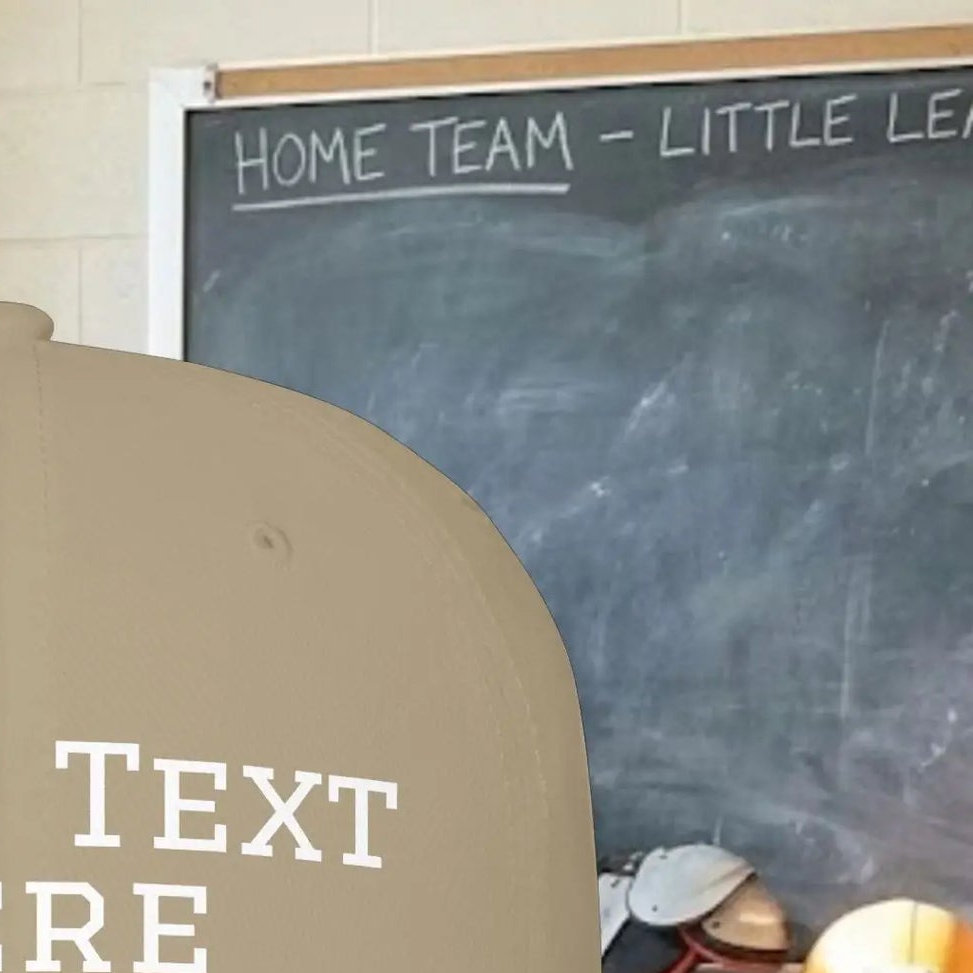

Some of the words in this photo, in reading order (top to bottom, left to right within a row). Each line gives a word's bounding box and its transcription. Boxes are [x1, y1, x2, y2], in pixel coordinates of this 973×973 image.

[234, 124, 386, 195] HOME
[410, 111, 575, 178] TEAM
[660, 95, 857, 158] LITTLE
[55, 740, 398, 869] TEXT
